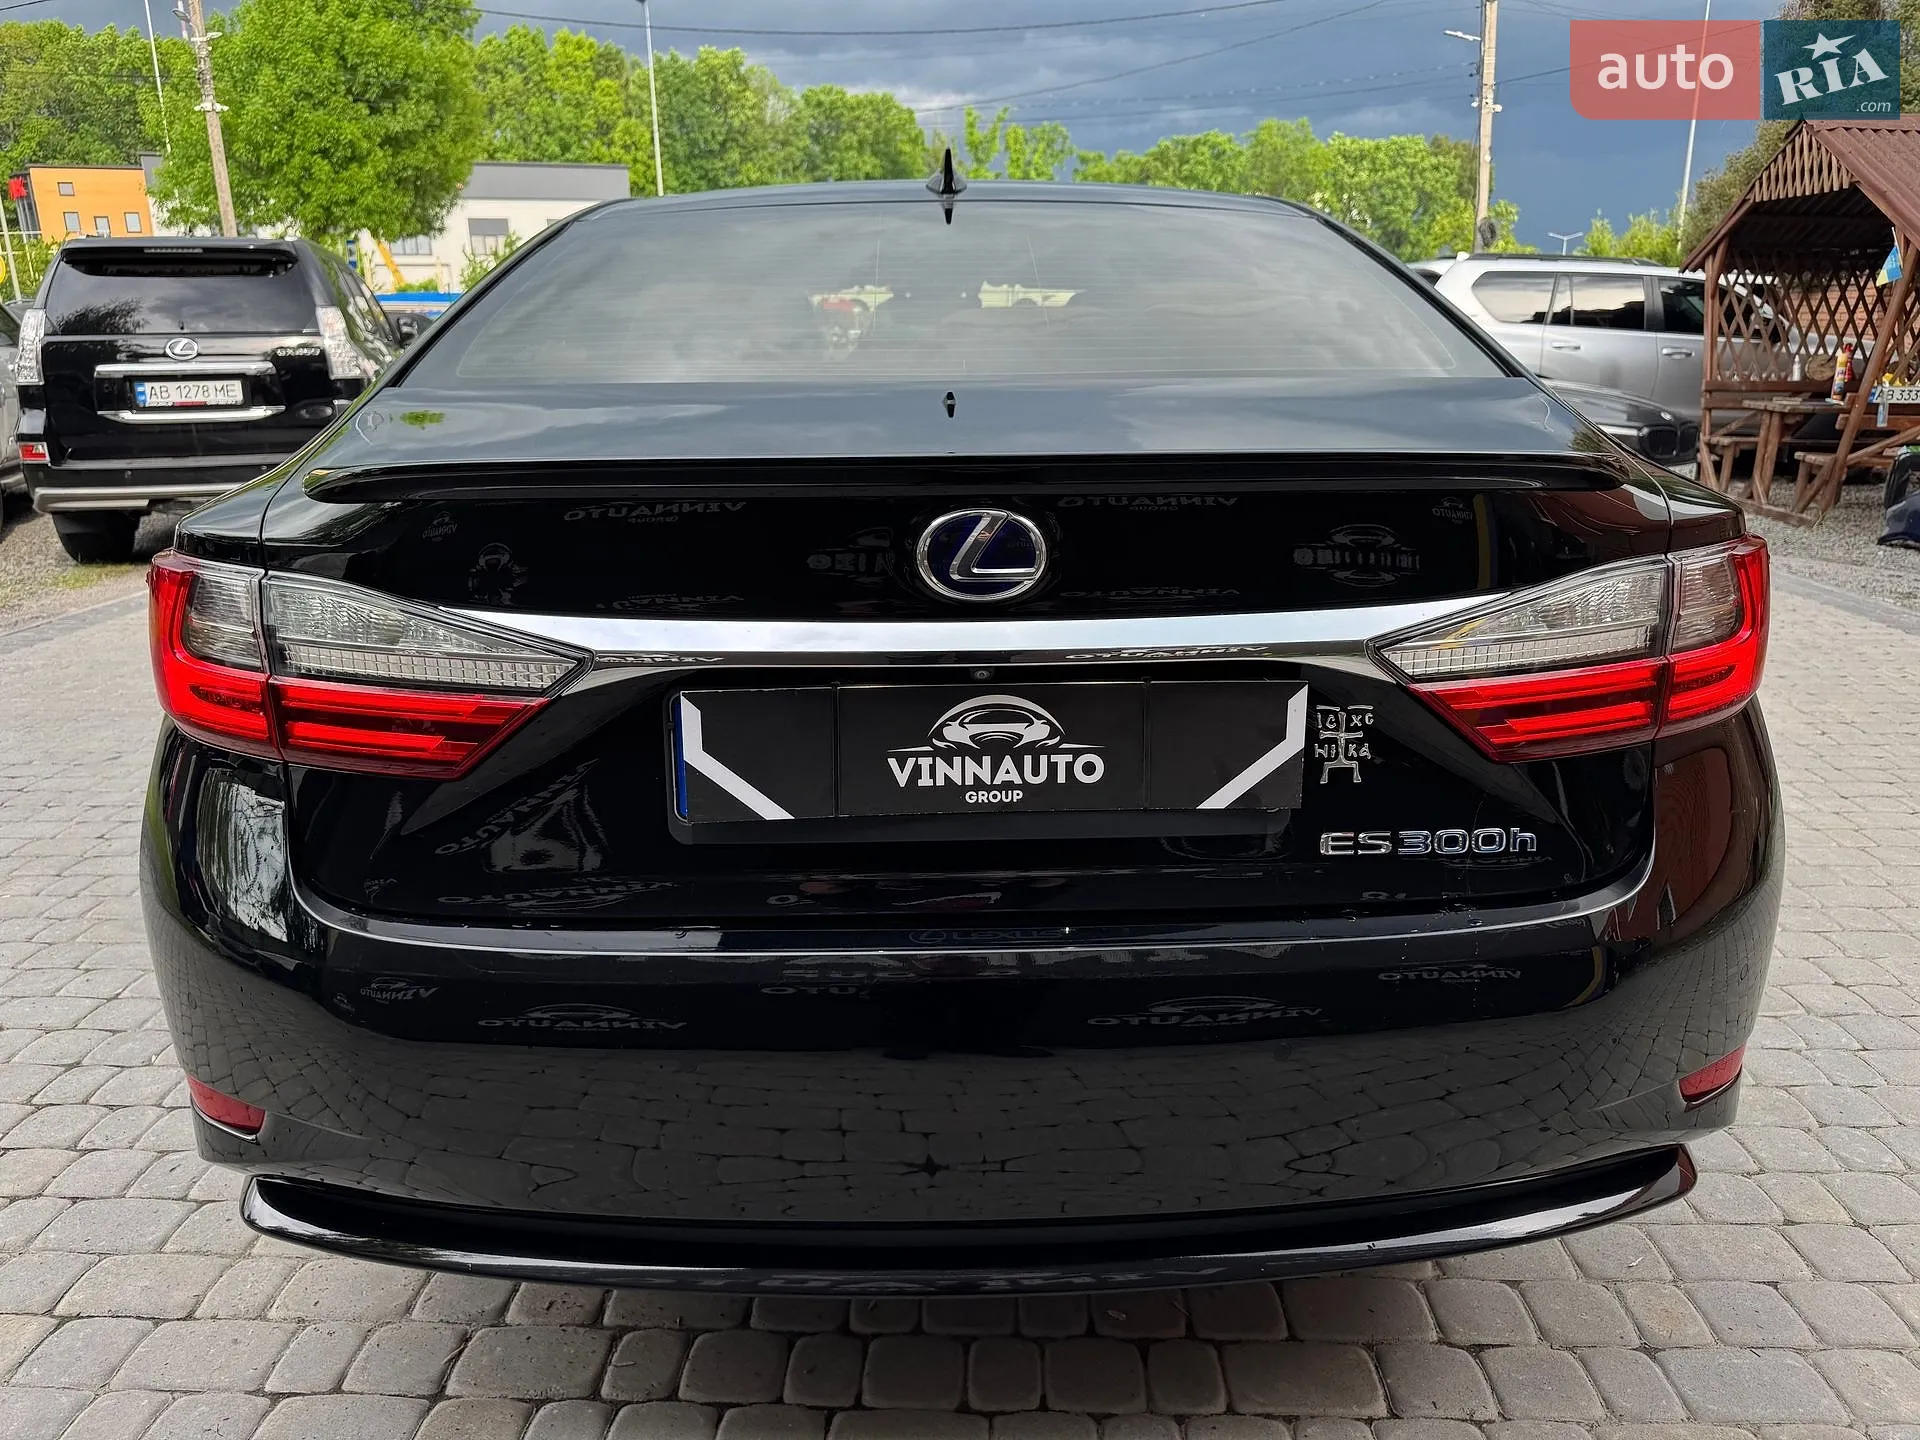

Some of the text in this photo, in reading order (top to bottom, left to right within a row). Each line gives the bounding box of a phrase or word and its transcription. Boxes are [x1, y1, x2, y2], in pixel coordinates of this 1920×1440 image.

[149, 383, 237, 400] AB 1278 ME
[888, 754, 1105, 788] VINNAUTO
[965, 790, 1023, 803] GROUP
